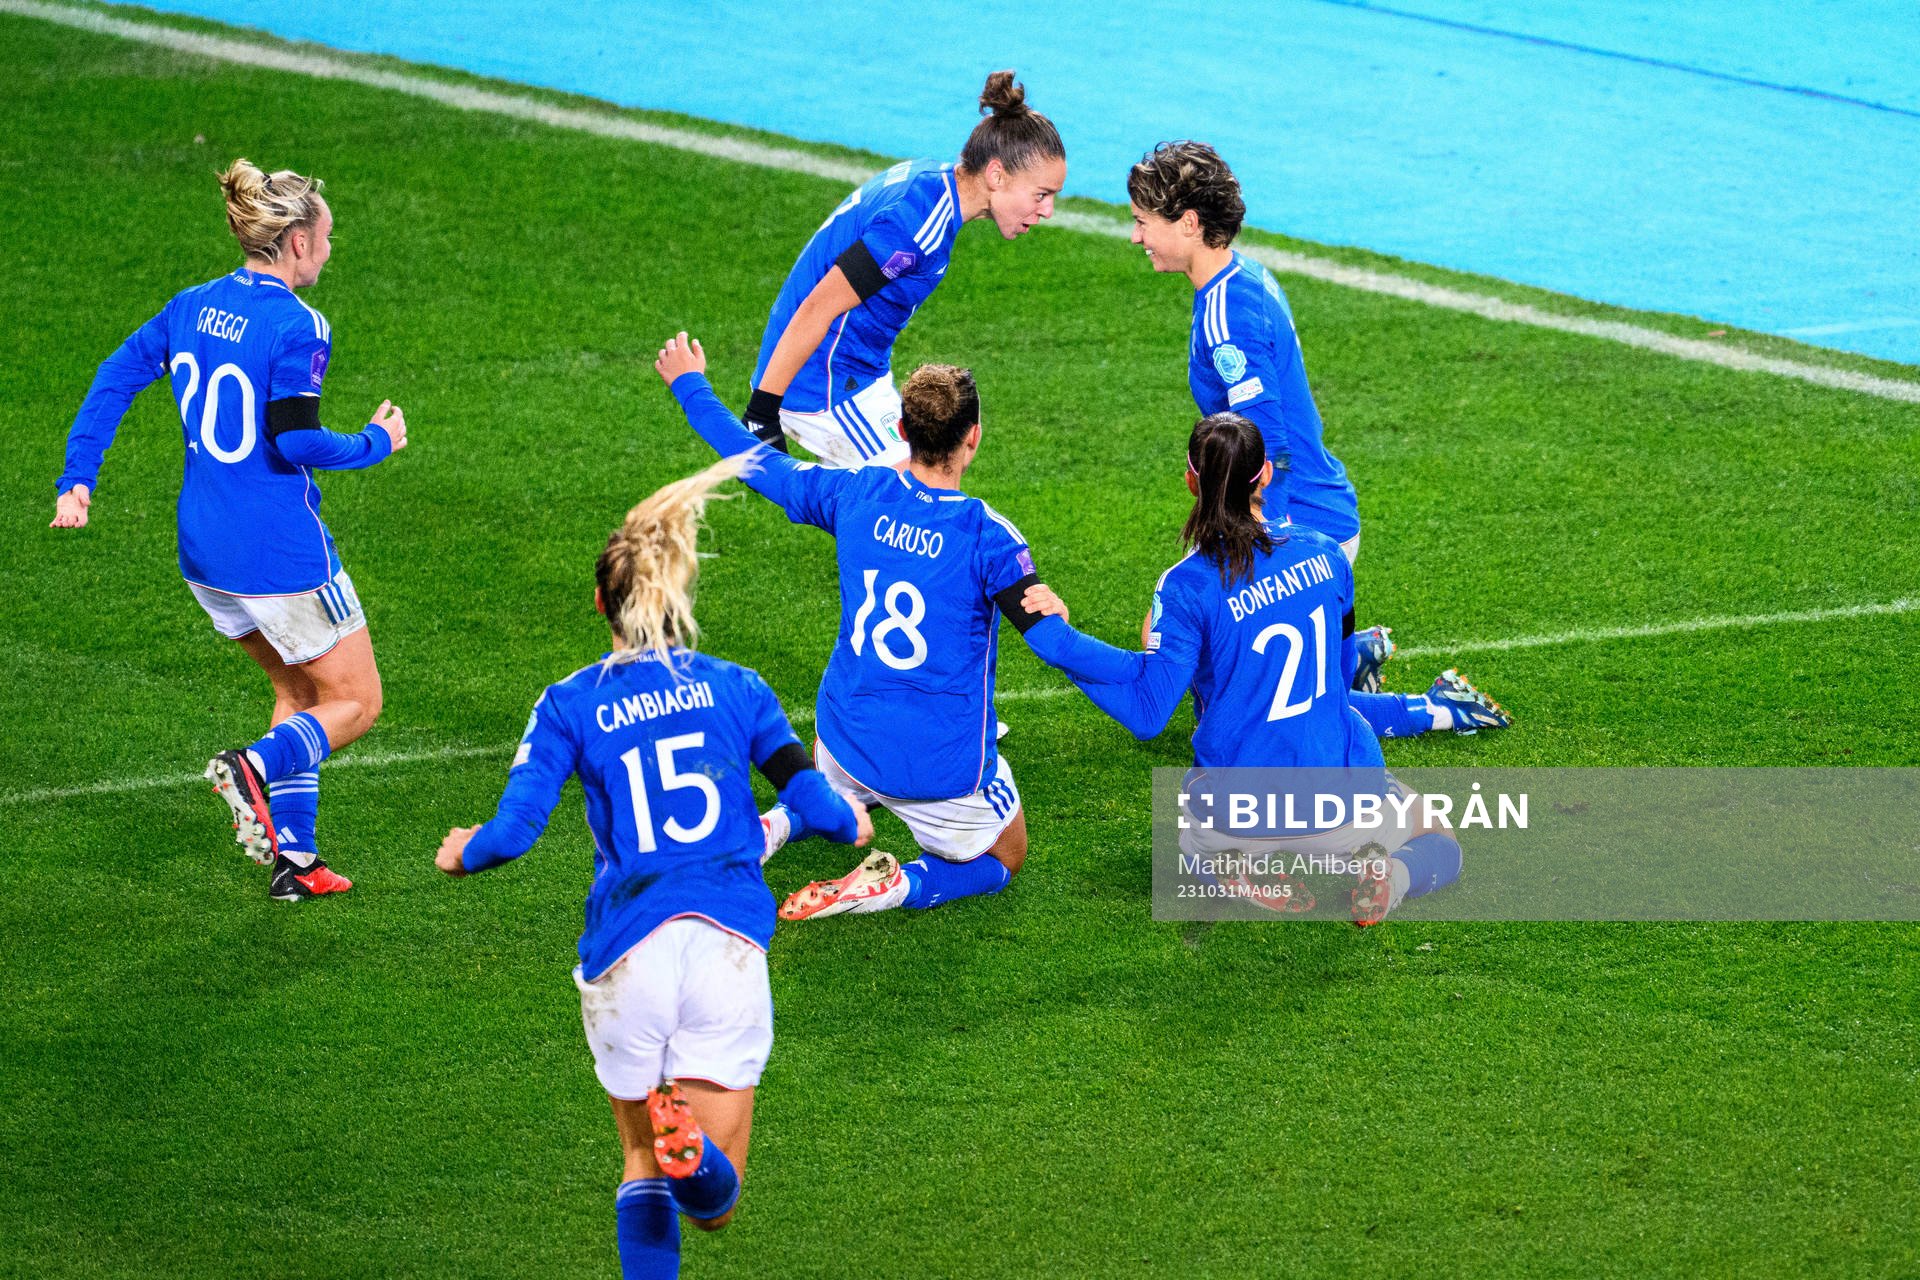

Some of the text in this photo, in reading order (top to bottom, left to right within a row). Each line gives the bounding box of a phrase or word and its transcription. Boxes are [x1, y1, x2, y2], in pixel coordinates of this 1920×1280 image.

[196, 306, 249, 344] GREGGI
[169, 351, 257, 464] 20
[873, 515, 944, 559] CARUSO
[850, 569, 928, 670] 18
[1227, 554, 1334, 623] BONFANTINI
[1251, 605, 1327, 722] 21
[596, 682, 714, 733] CAMBIAGHI
[620, 731, 721, 853] 15
